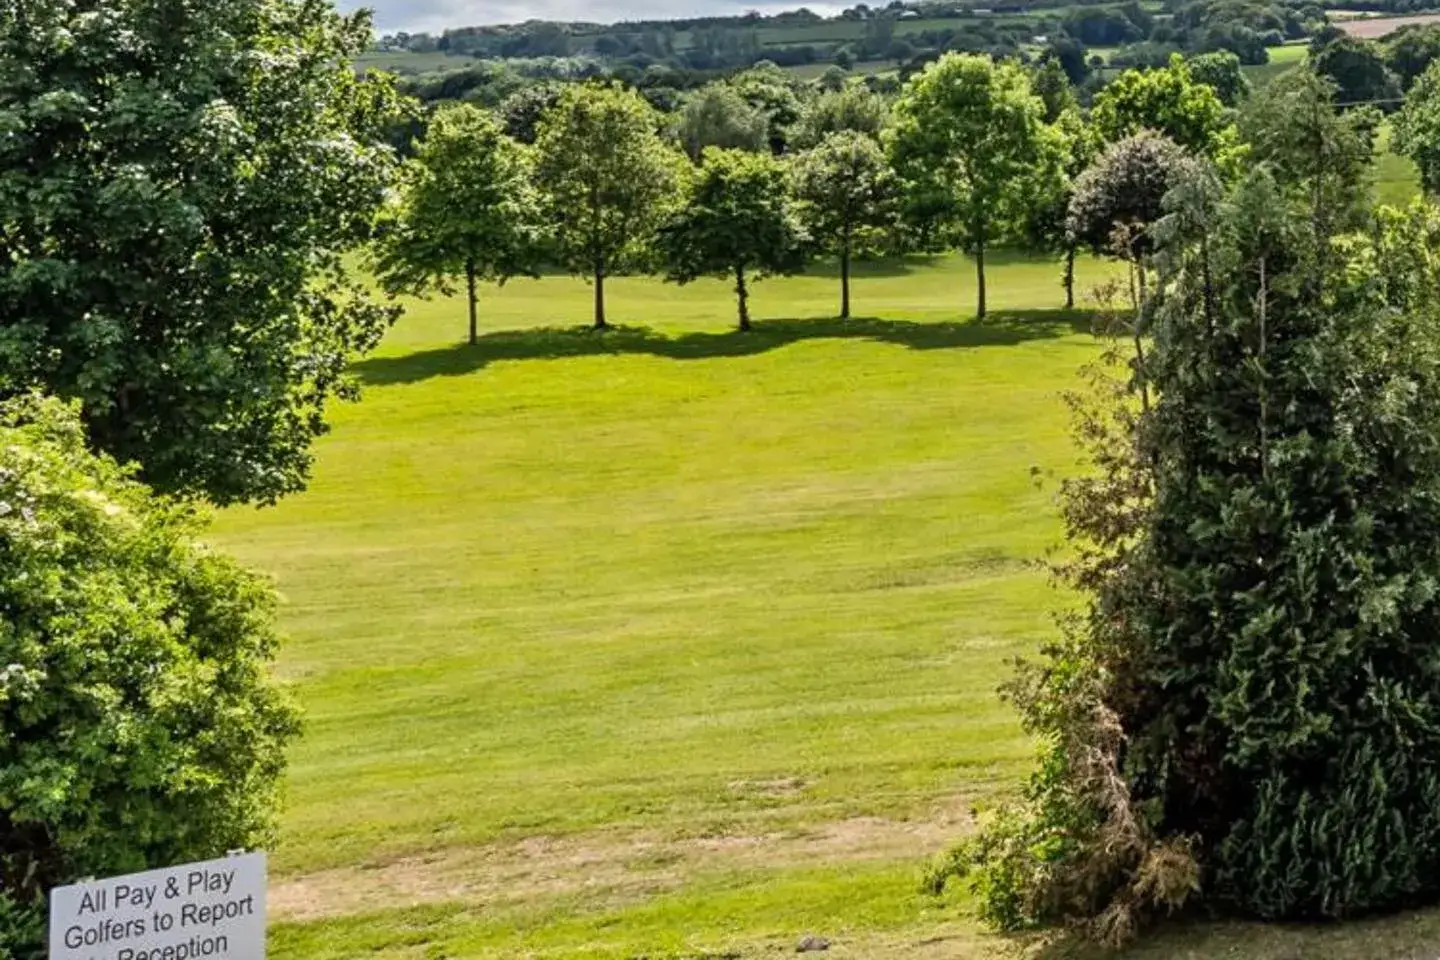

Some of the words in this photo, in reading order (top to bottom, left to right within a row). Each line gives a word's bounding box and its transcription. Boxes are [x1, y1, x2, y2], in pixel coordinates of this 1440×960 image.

[78, 889, 106, 915] All
[115, 885, 158, 910] Pay
[164, 877, 180, 899] &
[187, 869, 235, 893] Play
[64, 917, 146, 949] Golfers
[153, 911, 174, 933] to
[181, 894, 254, 928] Report
[118, 934, 228, 960] Reception
